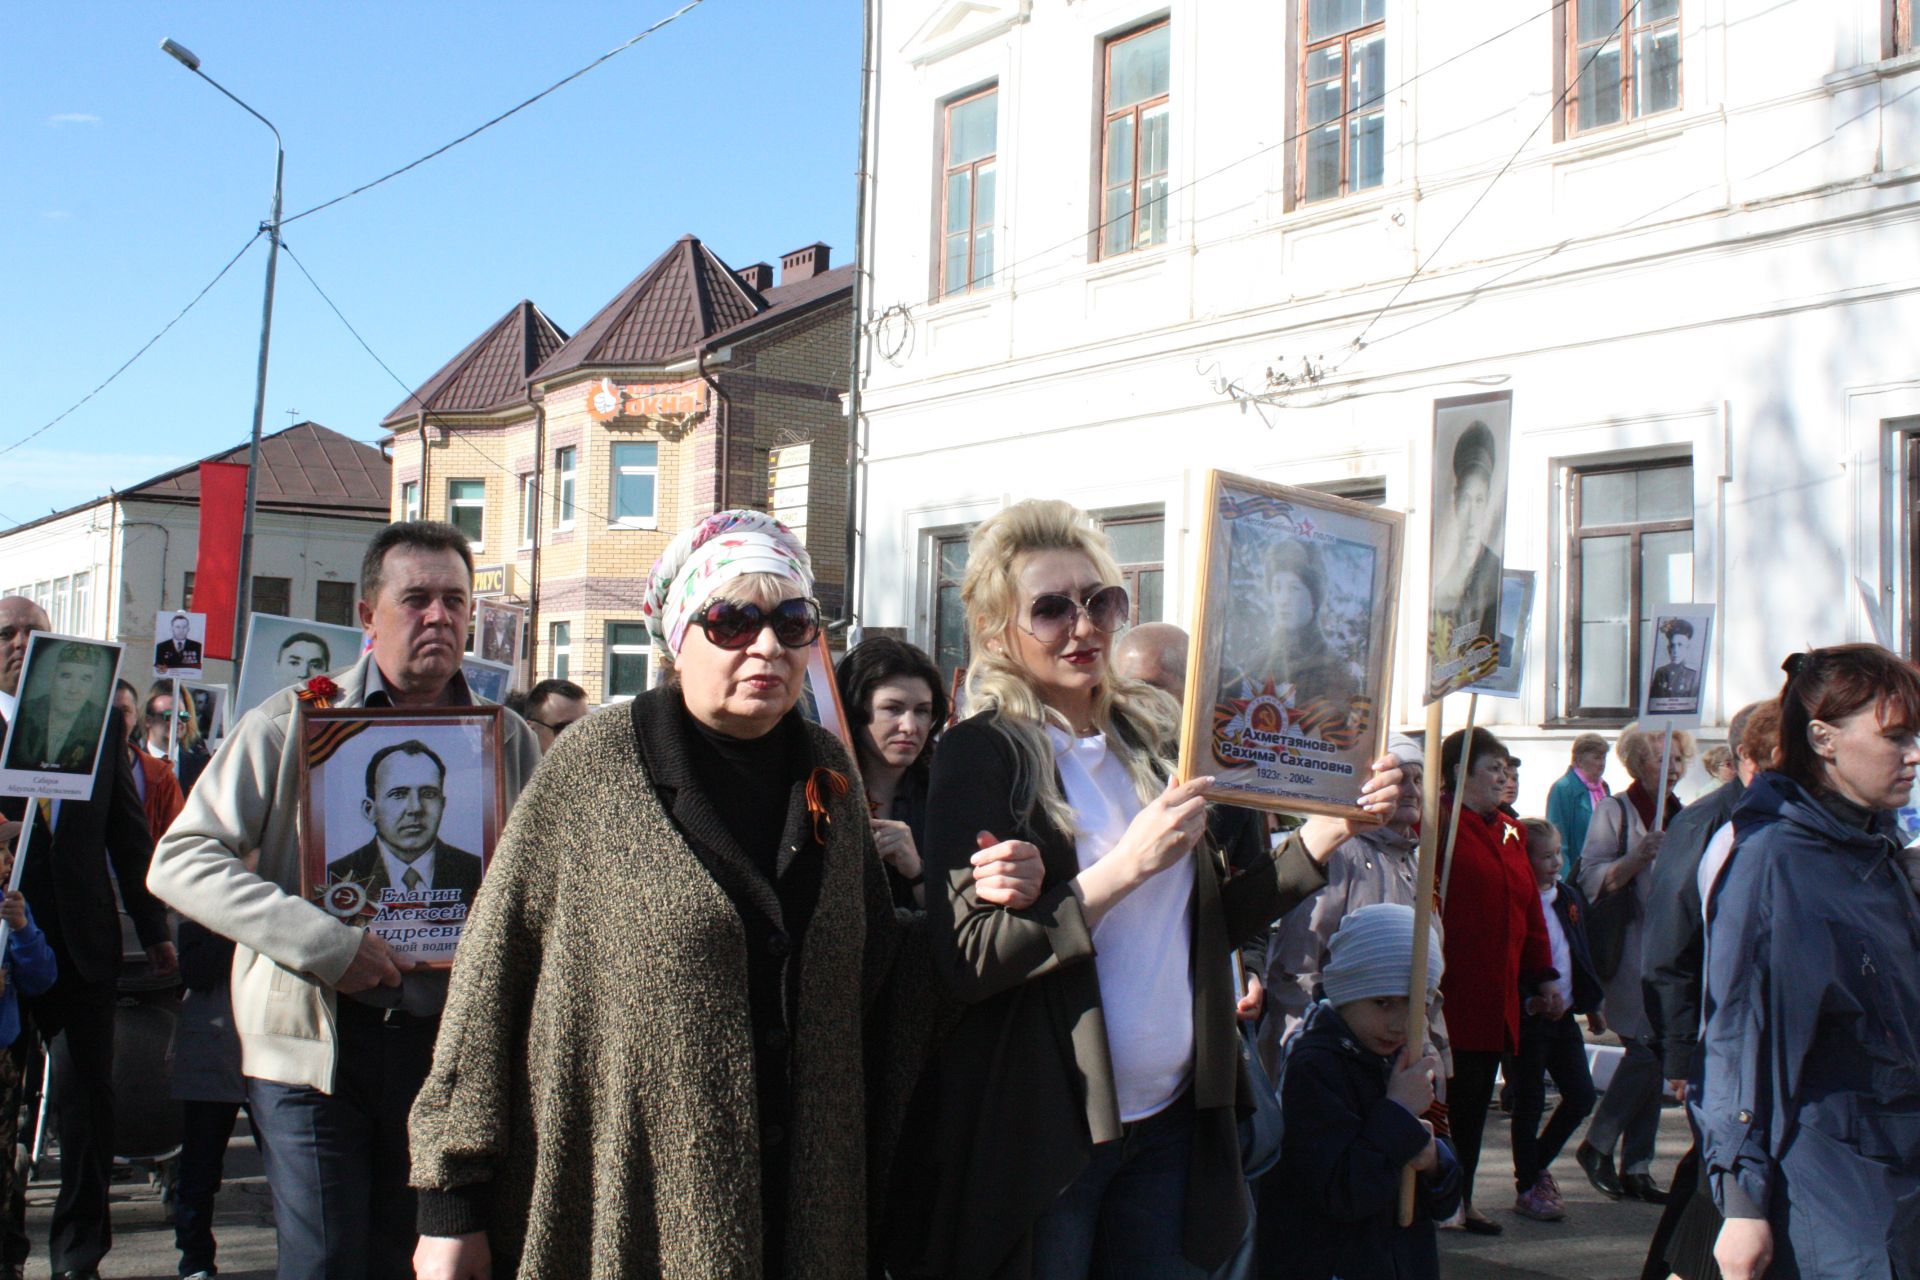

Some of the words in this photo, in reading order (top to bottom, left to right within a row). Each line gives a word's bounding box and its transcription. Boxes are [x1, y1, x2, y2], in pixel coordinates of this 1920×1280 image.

[472, 570, 502, 592] РИУС
[1242, 728, 1336, 753] Ахметзянова
[1221, 743, 1276, 762] Рахима
[1280, 753, 1353, 775] Сахаповна
[1256, 768, 1282, 780] 1923г.
[382, 888, 460, 903] Елагин
[374, 905, 466, 921] Алексей
[422, 942, 457, 952] водит
